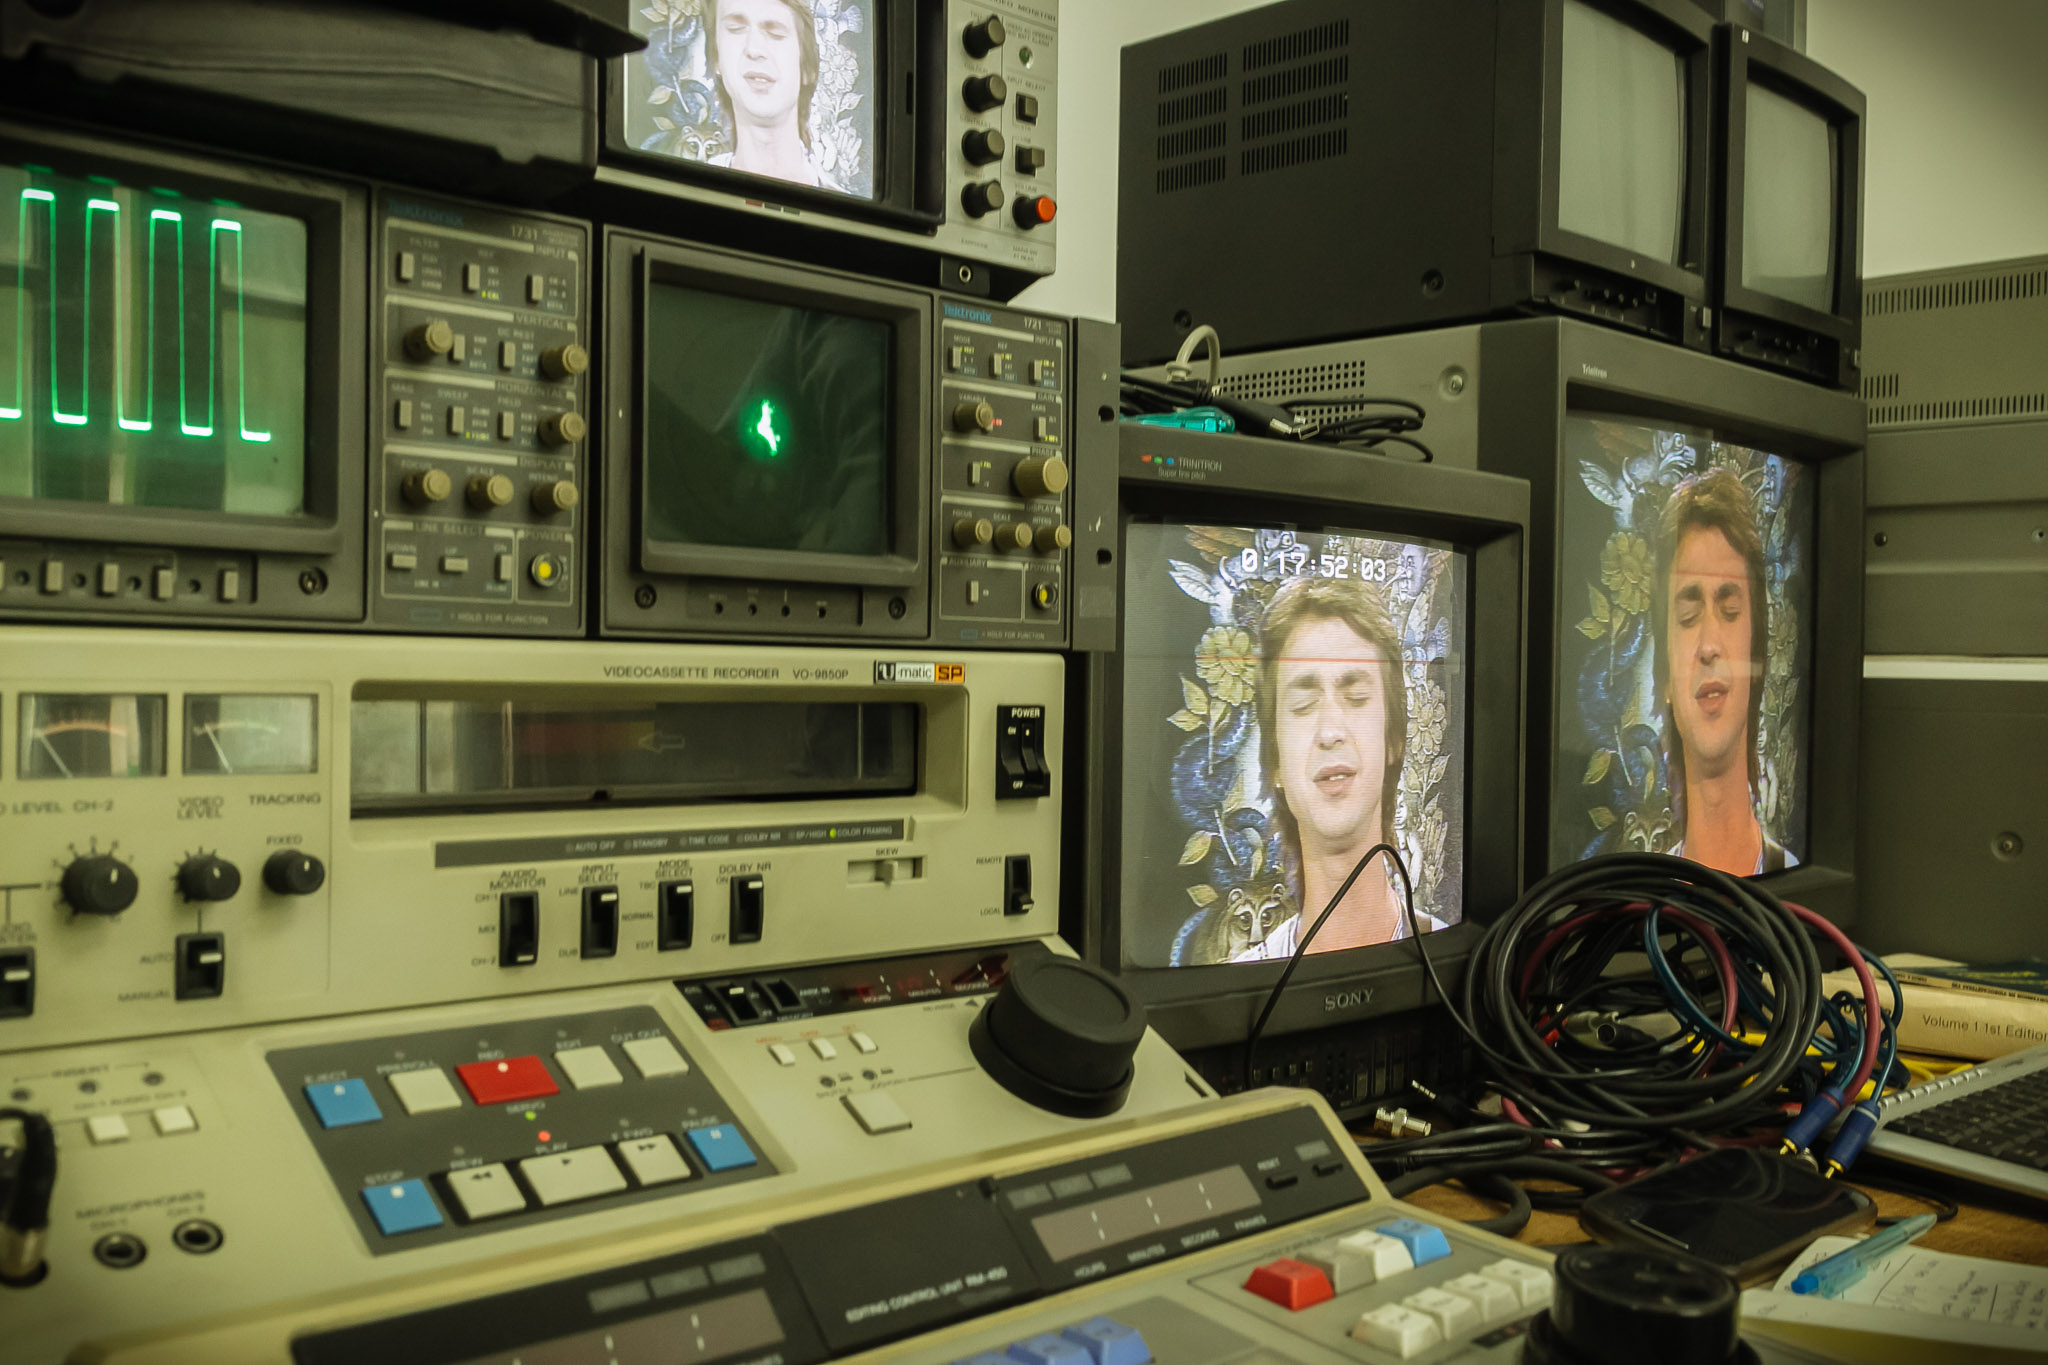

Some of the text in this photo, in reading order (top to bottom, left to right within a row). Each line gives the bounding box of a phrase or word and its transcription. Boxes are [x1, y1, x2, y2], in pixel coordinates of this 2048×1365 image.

[943, 303, 992, 325] Tektronix
[515, 312, 566, 332] VERTICAL
[1024, 317, 1042, 332] 1721
[1179, 457, 1222, 473] TRINITRON
[952, 509, 973, 519] FOCUS
[603, 664, 709, 680] VIDEOCASSETTE
[713, 666, 780, 681] RECORDER
[937, 665, 963, 681] SP
[1011, 707, 1041, 719] POWER
[1007, 726, 1017, 736] ON
[1012, 781, 1024, 790] OFF
[178, 796, 225, 809] VIDEO
[249, 793, 321, 806] TRACKING
[177, 808, 222, 821] LEVEL
[837, 825, 893, 838] COLOR FRAMING
[266, 834, 303, 846] FIXED
[633, 837, 668, 849] STANDBY
[876, 847, 899, 857] SKEW
[659, 859, 690, 869] MODE
[976, 855, 1002, 865] REMOTE
[501, 868, 537, 880] AUDIO
[583, 863, 615, 874] INPUT
[655, 867, 693, 879] SELECT
[719, 861, 771, 875] DOLBY NR
[490, 876, 546, 890] MONITOR
[579, 872, 619, 884] SELECT
[716, 875, 729, 885] ON
[622, 912, 655, 922] NORMAL
[980, 906, 1001, 917] LOCAL
[711, 933, 727, 944] OFF
[1324, 988, 1375, 1012] SONY
[1922, 1013, 1969, 1032] Volume
[1257, 1157, 1281, 1172] RESET
[364, 1171, 403, 1184] STOP
[1074, 1261, 1107, 1278] HOURS
[845, 1300, 889, 1324] EDITING
[889, 1286, 940, 1311] CONTROL
